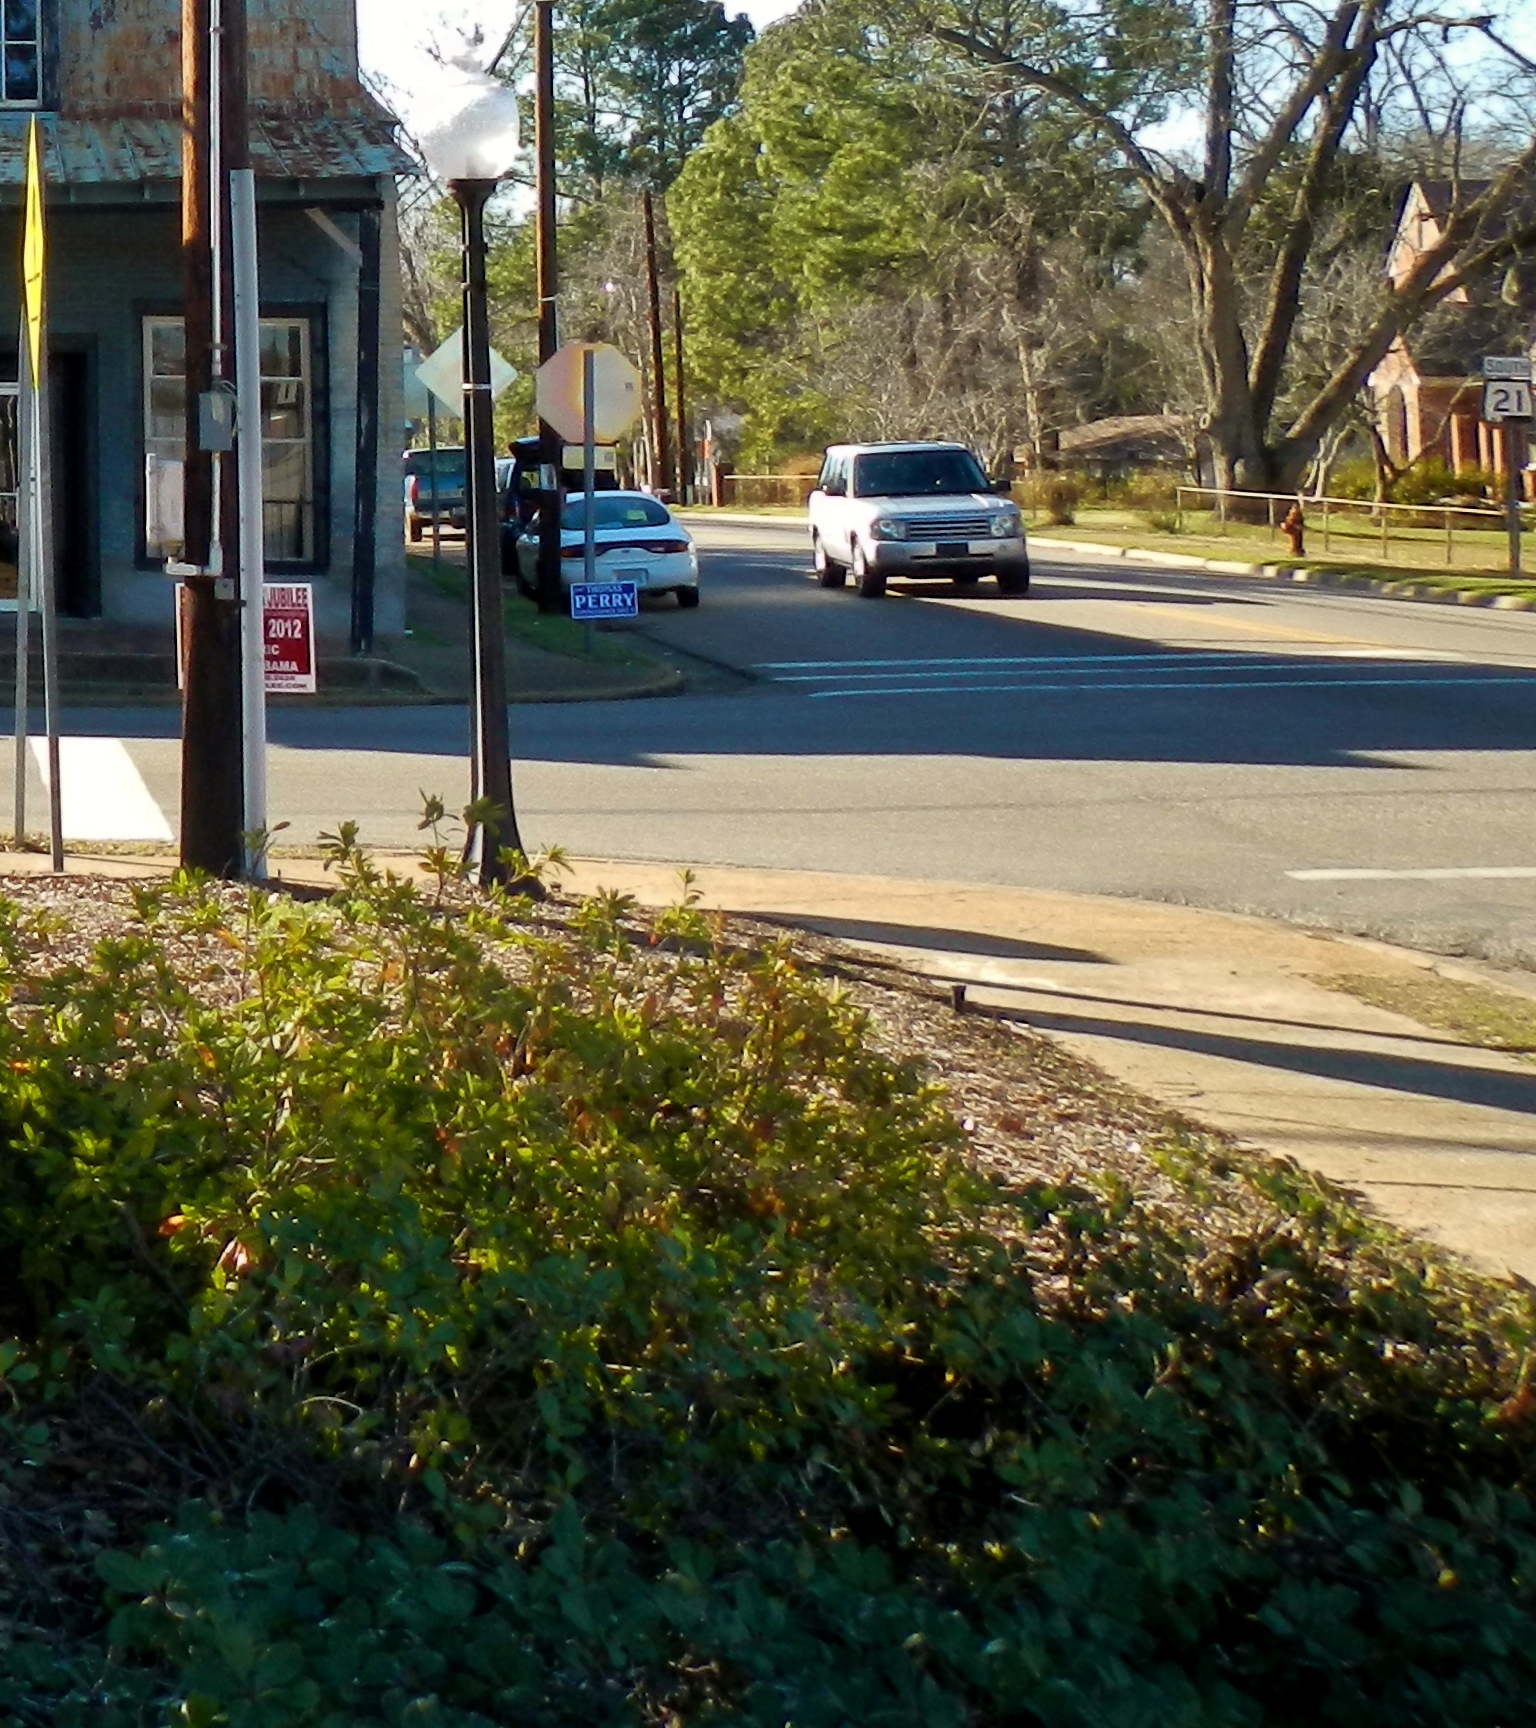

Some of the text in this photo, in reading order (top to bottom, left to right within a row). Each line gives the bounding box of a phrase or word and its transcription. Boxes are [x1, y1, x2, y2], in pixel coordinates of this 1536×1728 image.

[1493, 389, 1524, 412] 21
[268, 587, 308, 606] JUBILEE
[575, 593, 634, 608] PERRY
[268, 618, 302, 639] 2012
[264, 660, 299, 673] BAMA
